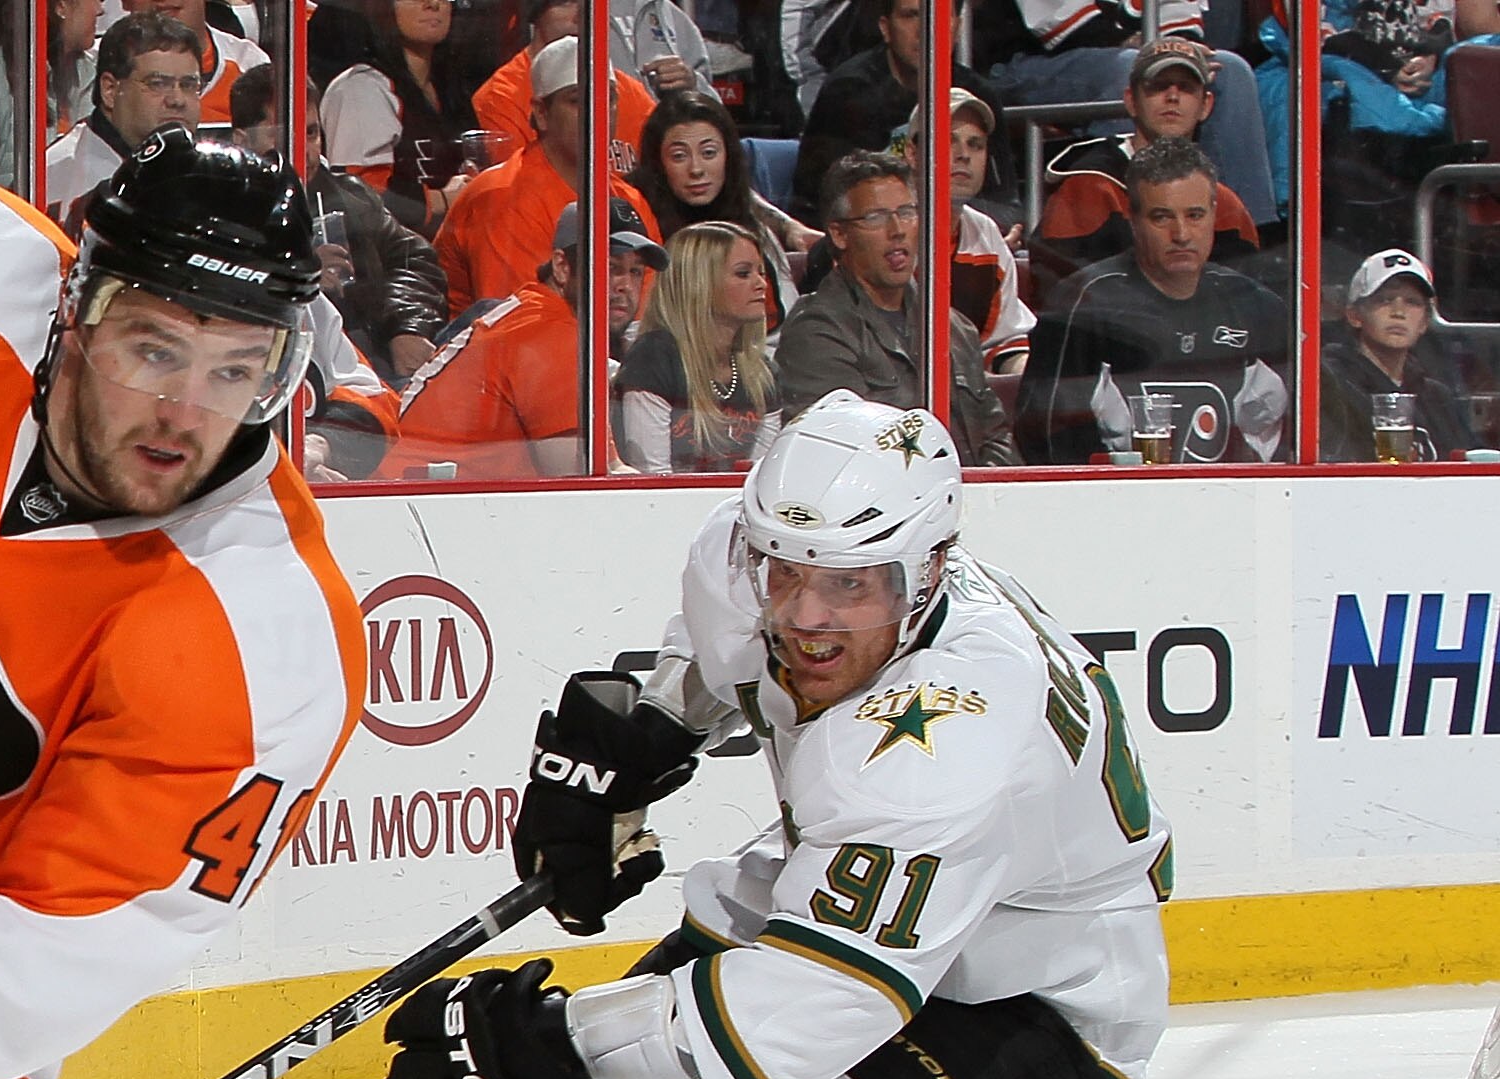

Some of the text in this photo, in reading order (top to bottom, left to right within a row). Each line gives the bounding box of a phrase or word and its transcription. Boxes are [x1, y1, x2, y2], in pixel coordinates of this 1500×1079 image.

[368, 617, 468, 704] KIA
[853, 683, 989, 721] STARS
[534, 746, 618, 795] ON
[809, 843, 942, 949] 91
